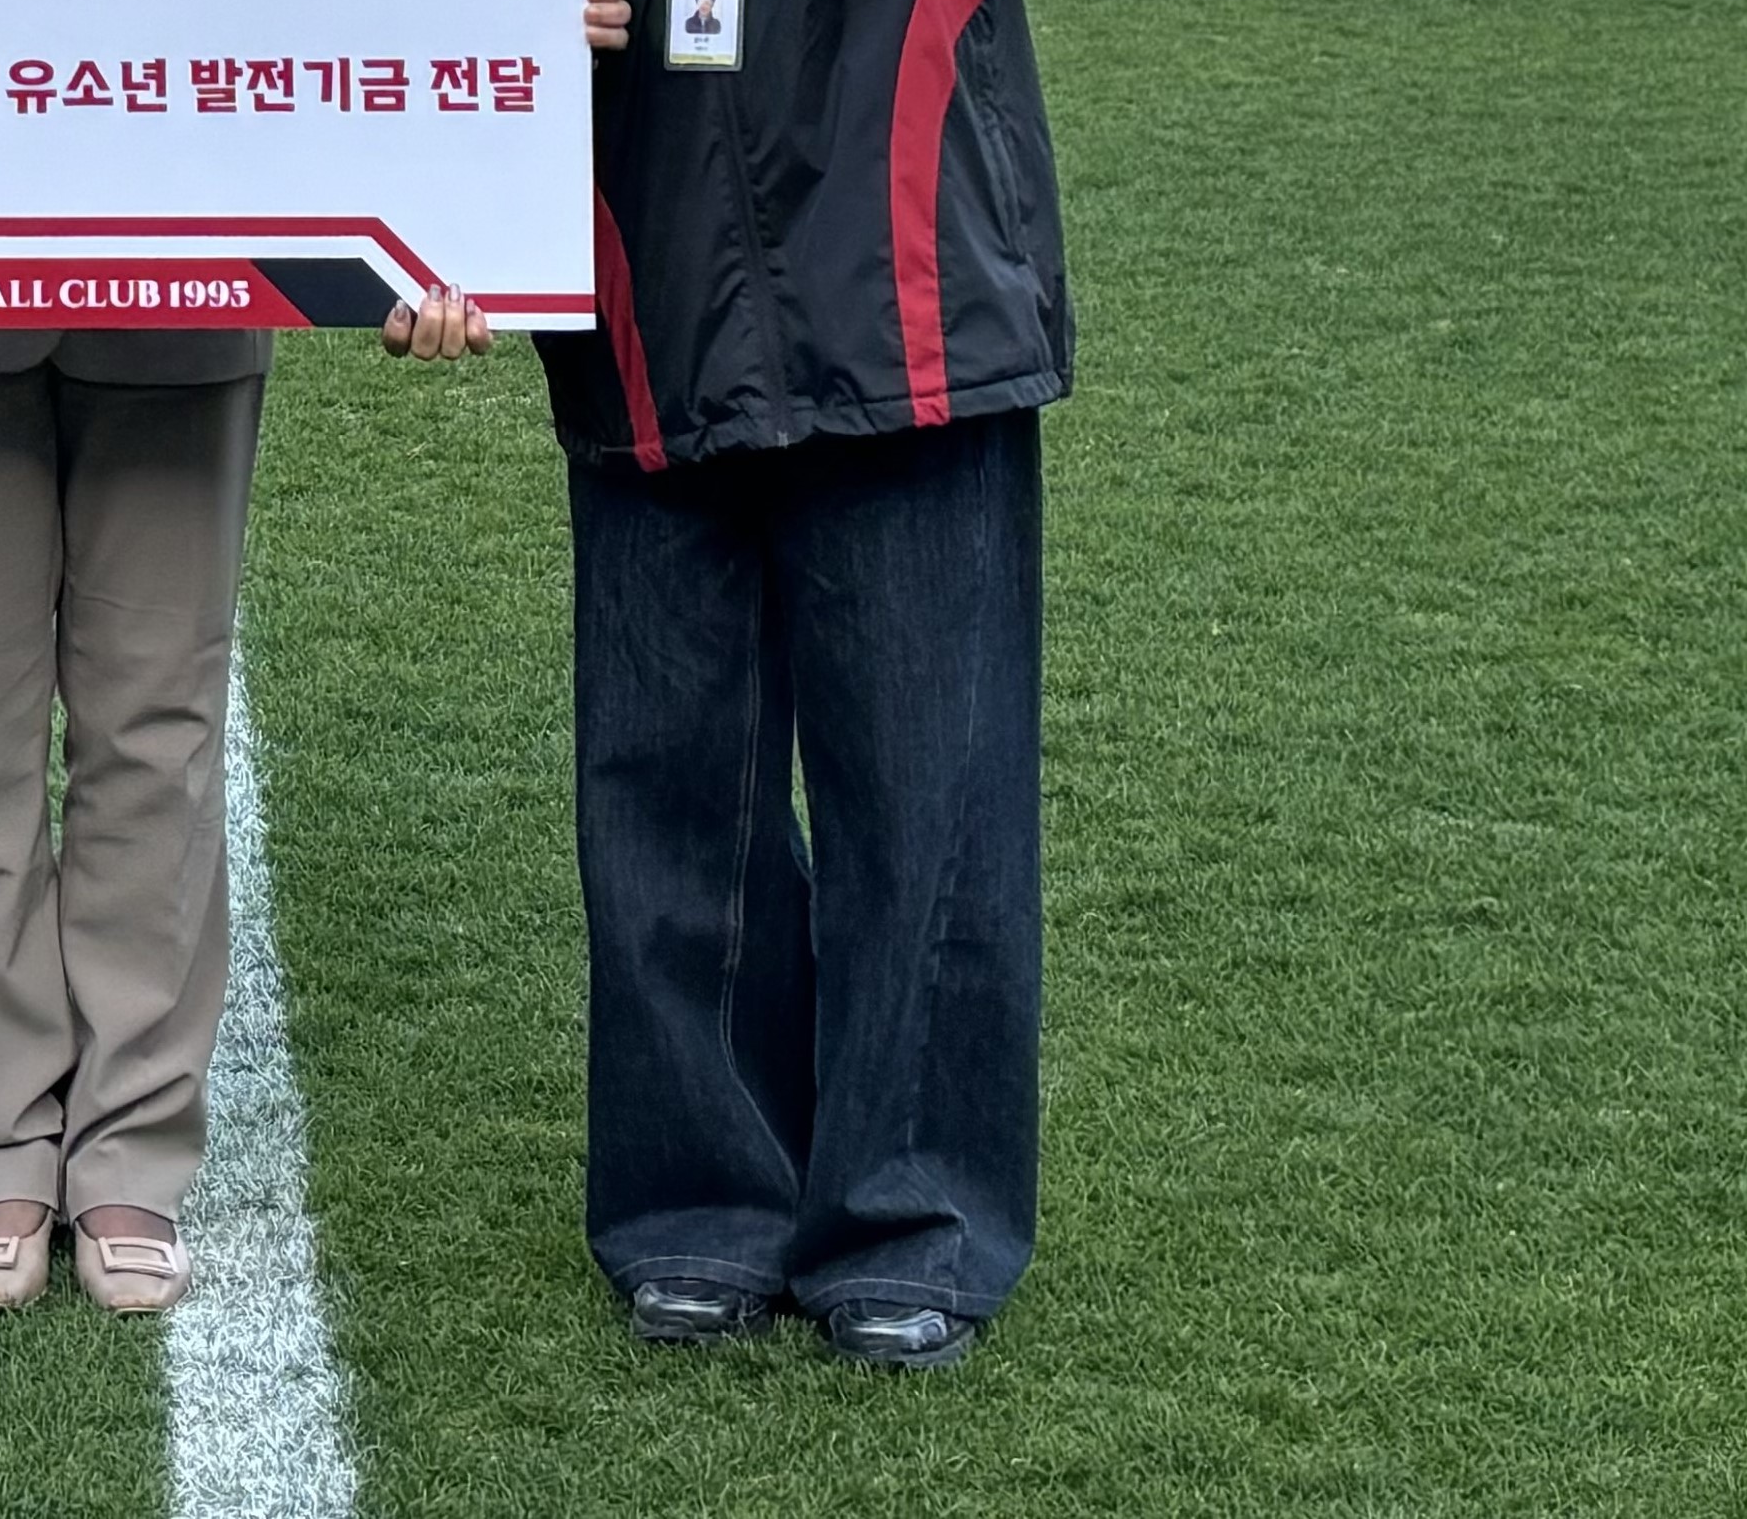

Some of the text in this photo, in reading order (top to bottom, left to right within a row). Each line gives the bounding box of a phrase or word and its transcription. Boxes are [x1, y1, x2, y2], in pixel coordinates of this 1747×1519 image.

[5, 58, 169, 115] 유소년
[189, 57, 410, 114] 발전기금
[429, 56, 541, 113] 전달
[59, 279, 161, 309] CLUB
[169, 279, 251, 309] 1995
